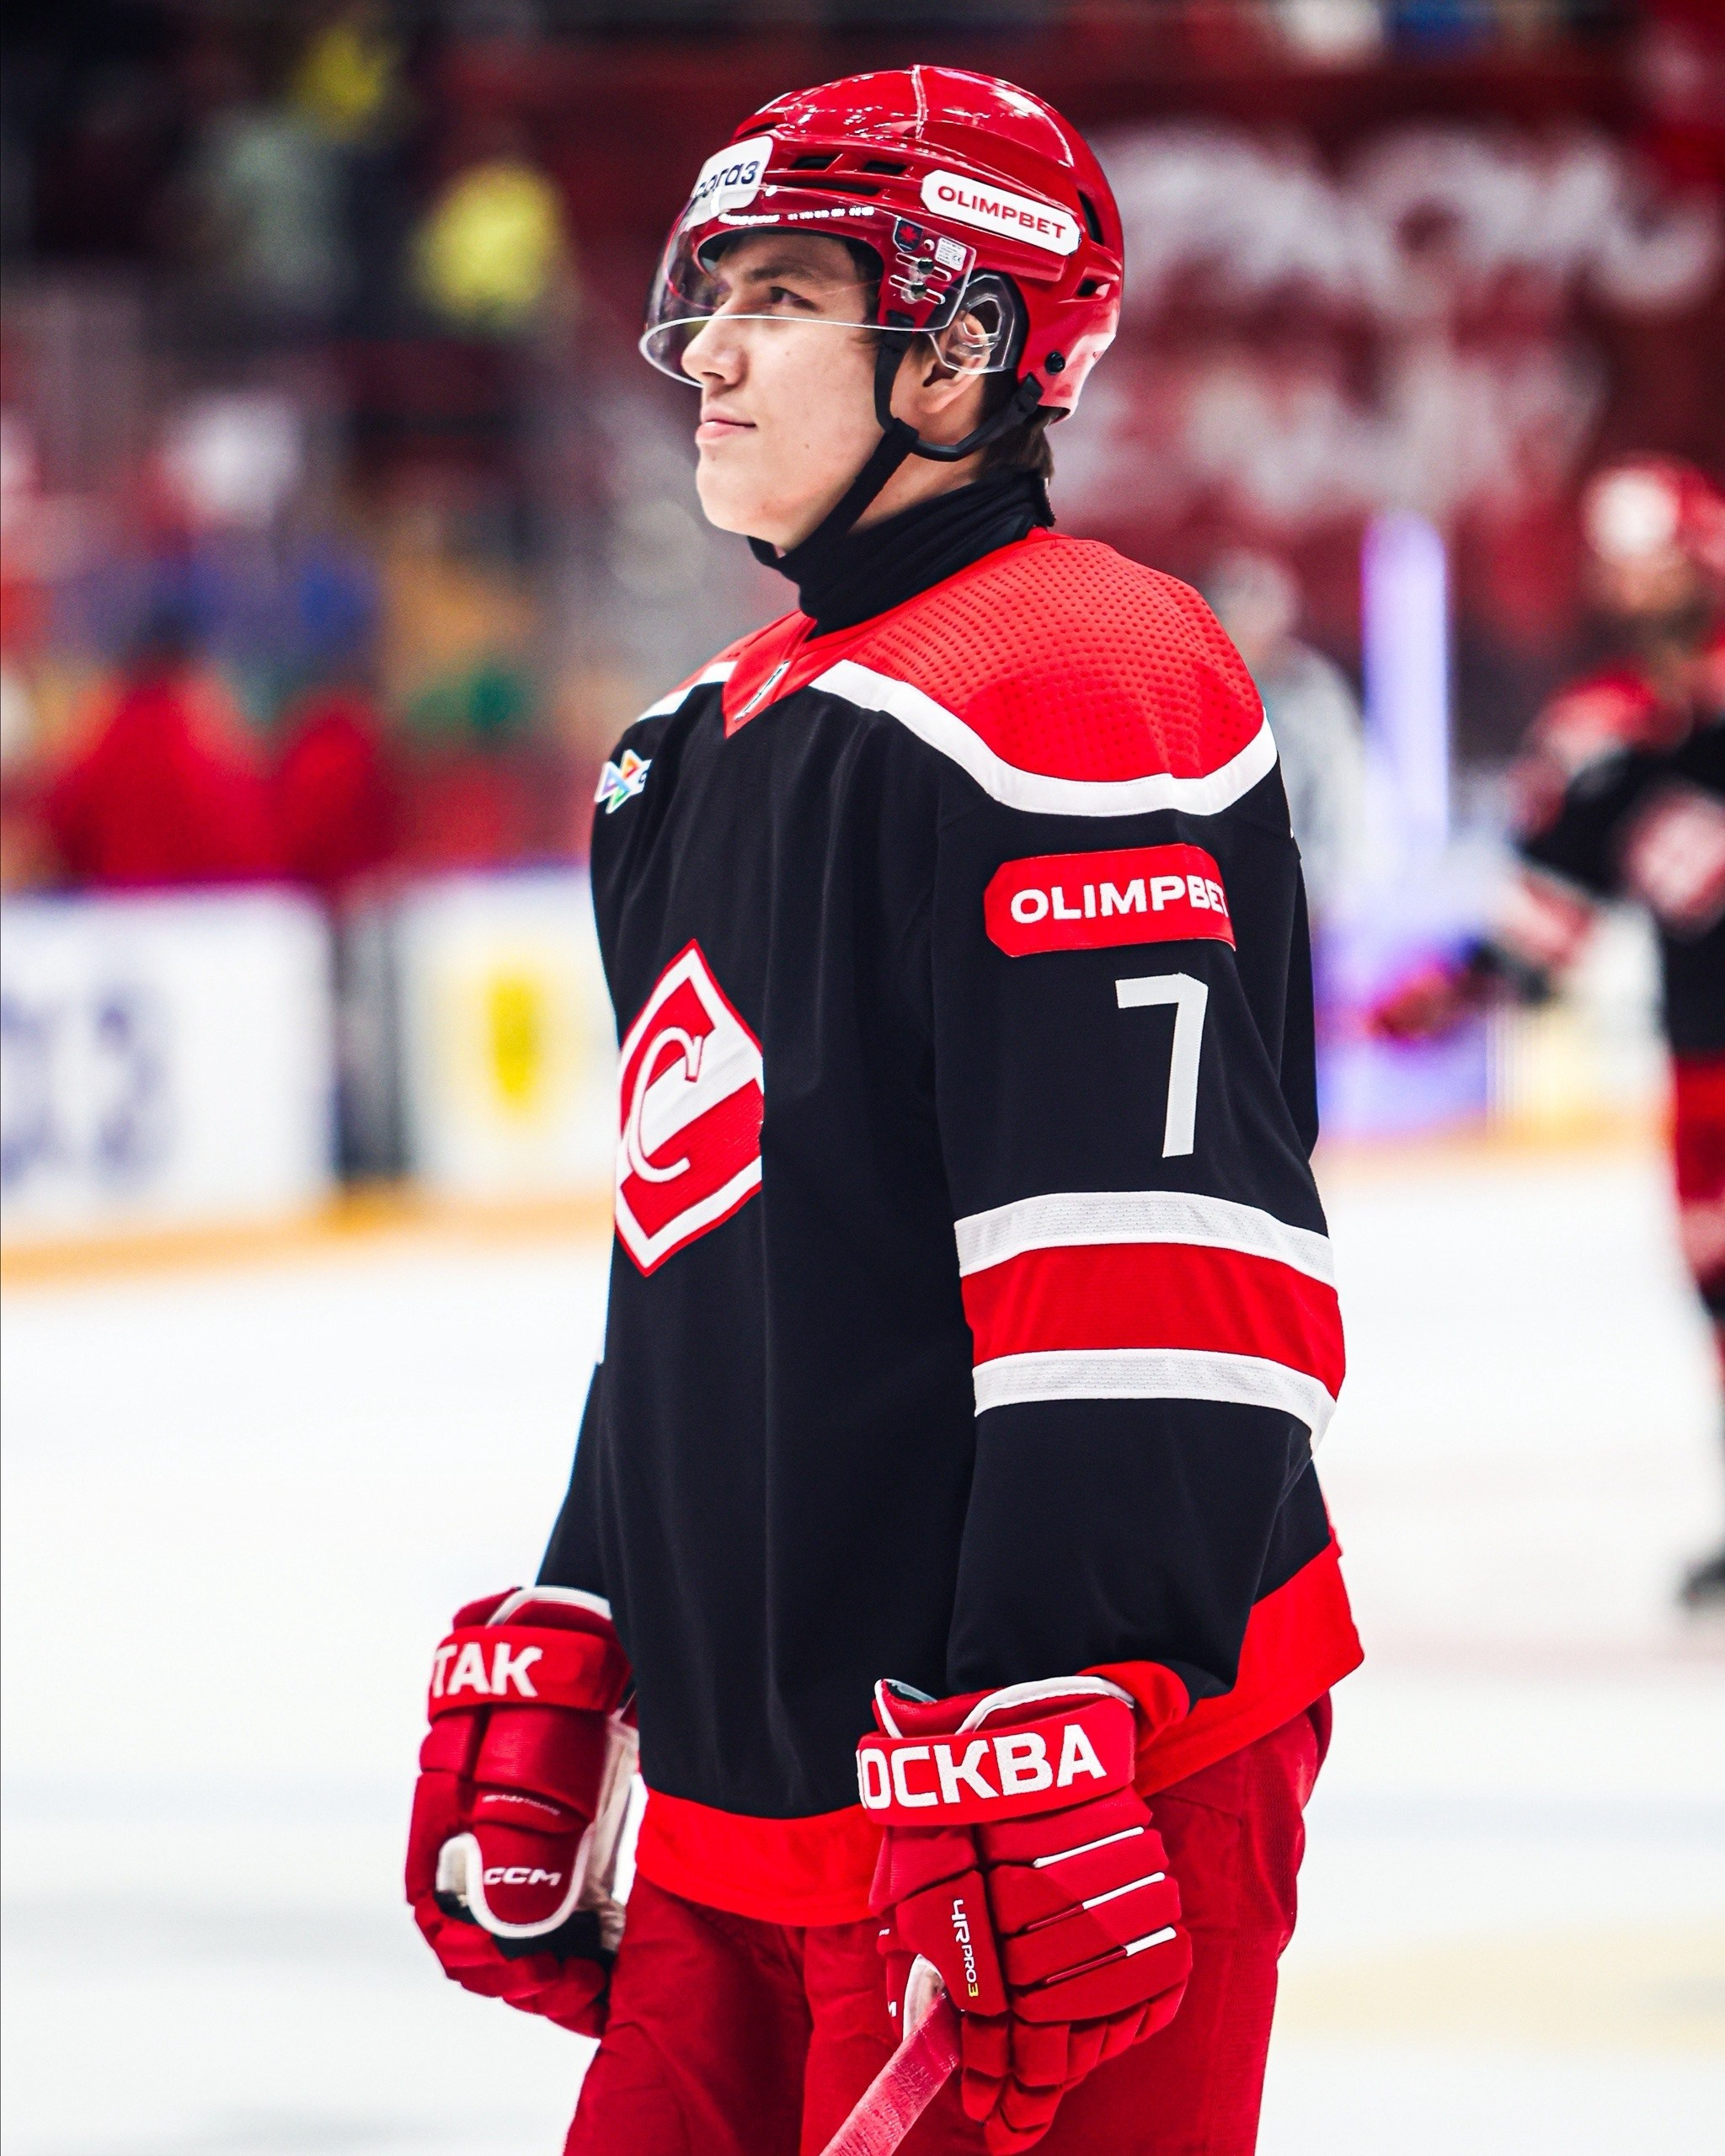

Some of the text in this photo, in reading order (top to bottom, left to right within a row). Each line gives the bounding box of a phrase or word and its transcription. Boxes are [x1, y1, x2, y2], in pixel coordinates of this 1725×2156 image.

[937, 178, 1066, 238] OLIMPBET
[1011, 874, 1229, 924] OLIMPBET
[1115, 972, 1209, 1158] 7
[856, 1724, 1108, 1810] ОСКВА
[483, 1867, 562, 1886] CCM
